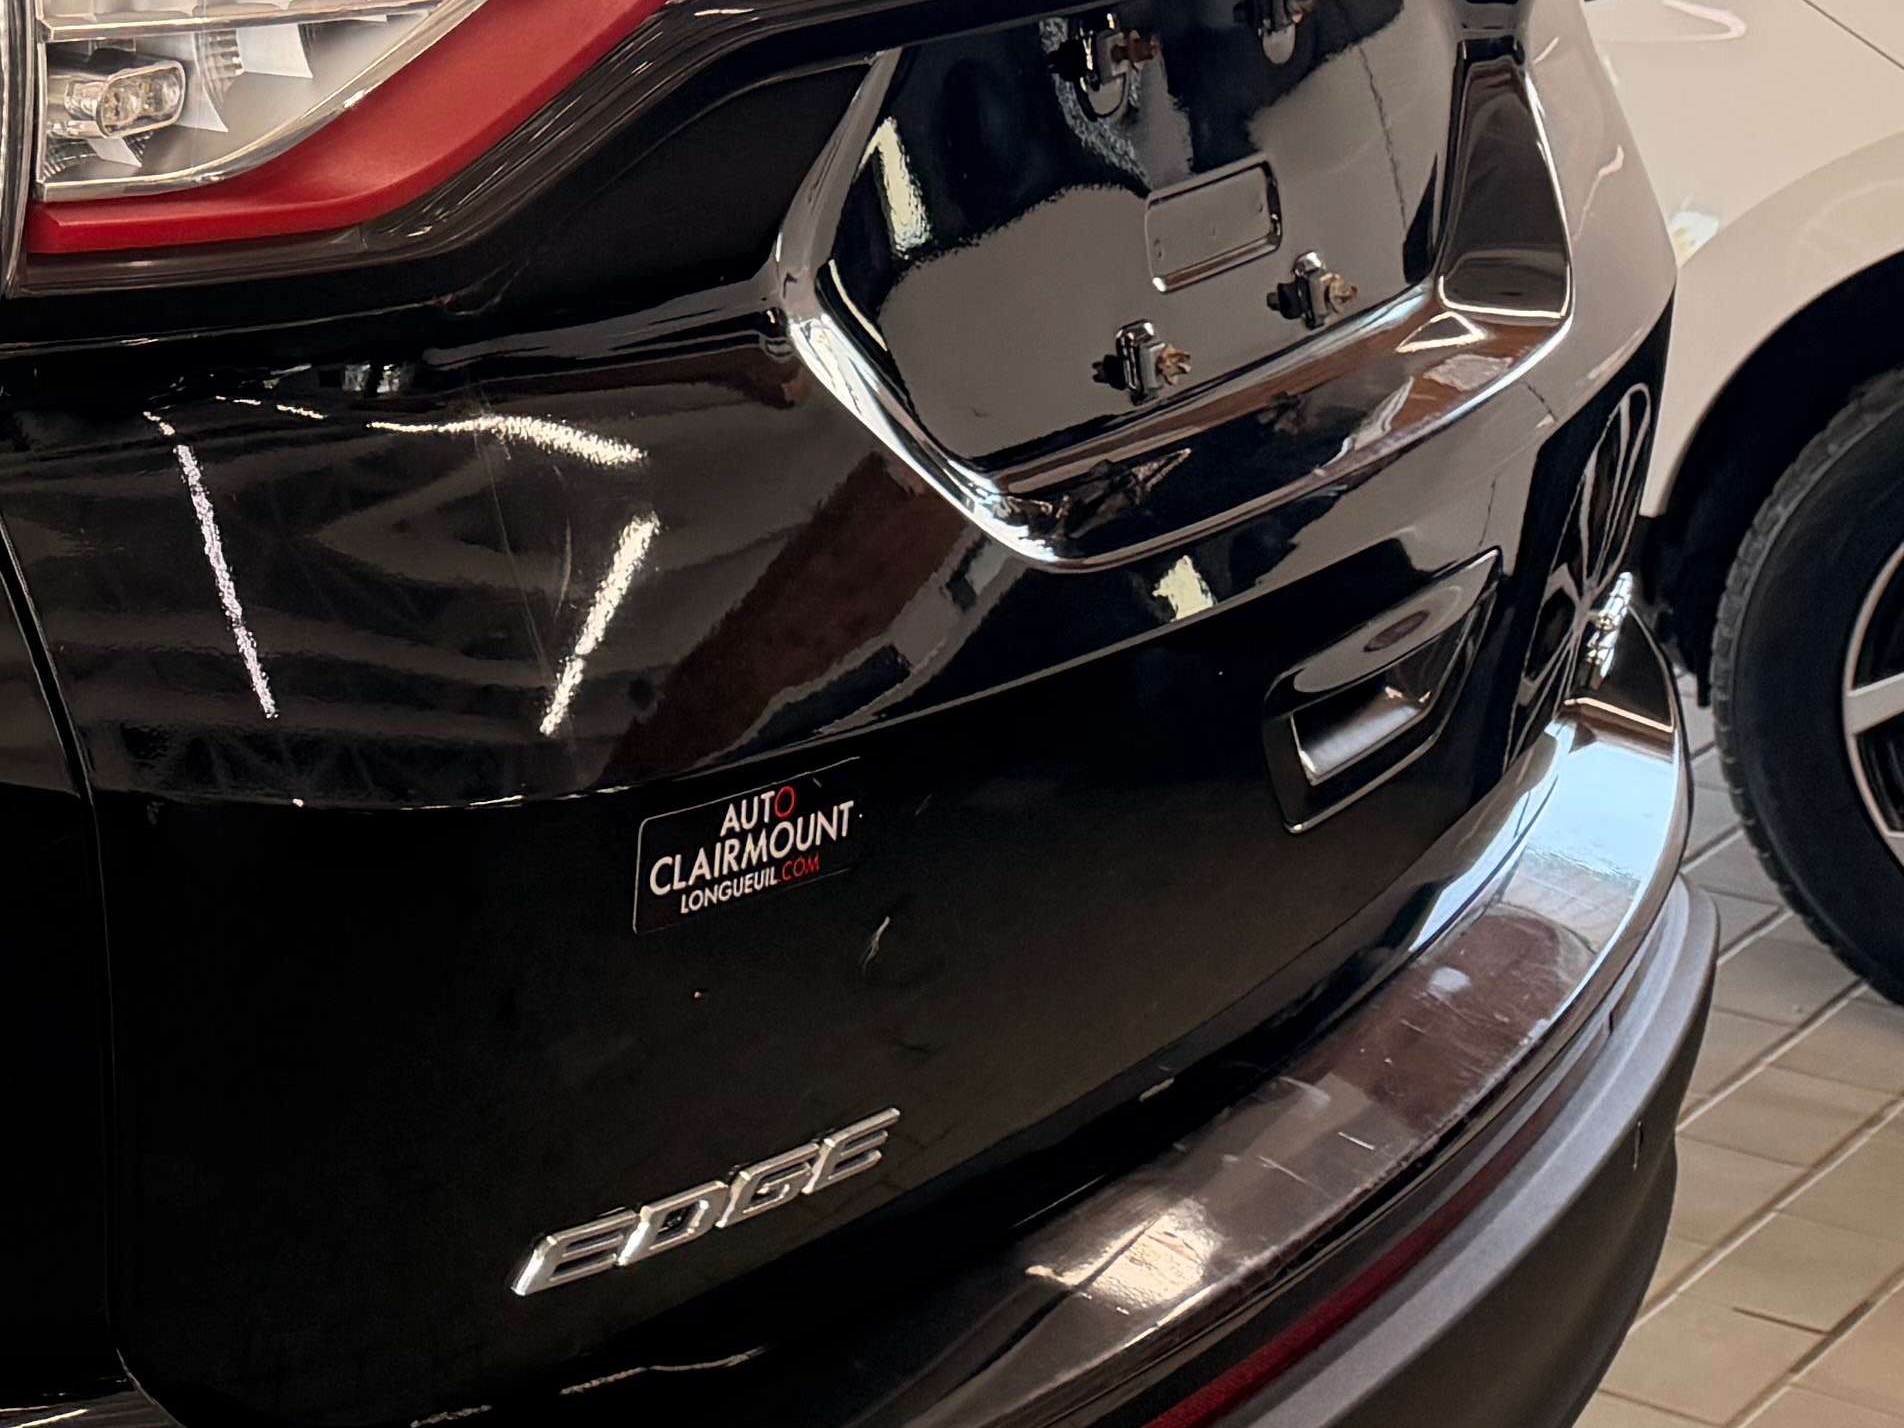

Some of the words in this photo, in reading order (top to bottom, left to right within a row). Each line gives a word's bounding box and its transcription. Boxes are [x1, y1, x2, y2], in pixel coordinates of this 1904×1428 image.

[649, 800, 855, 896] CLAIRMOUNT
[719, 785, 797, 838] AUTO
[509, 1106, 903, 1298] EDGE
